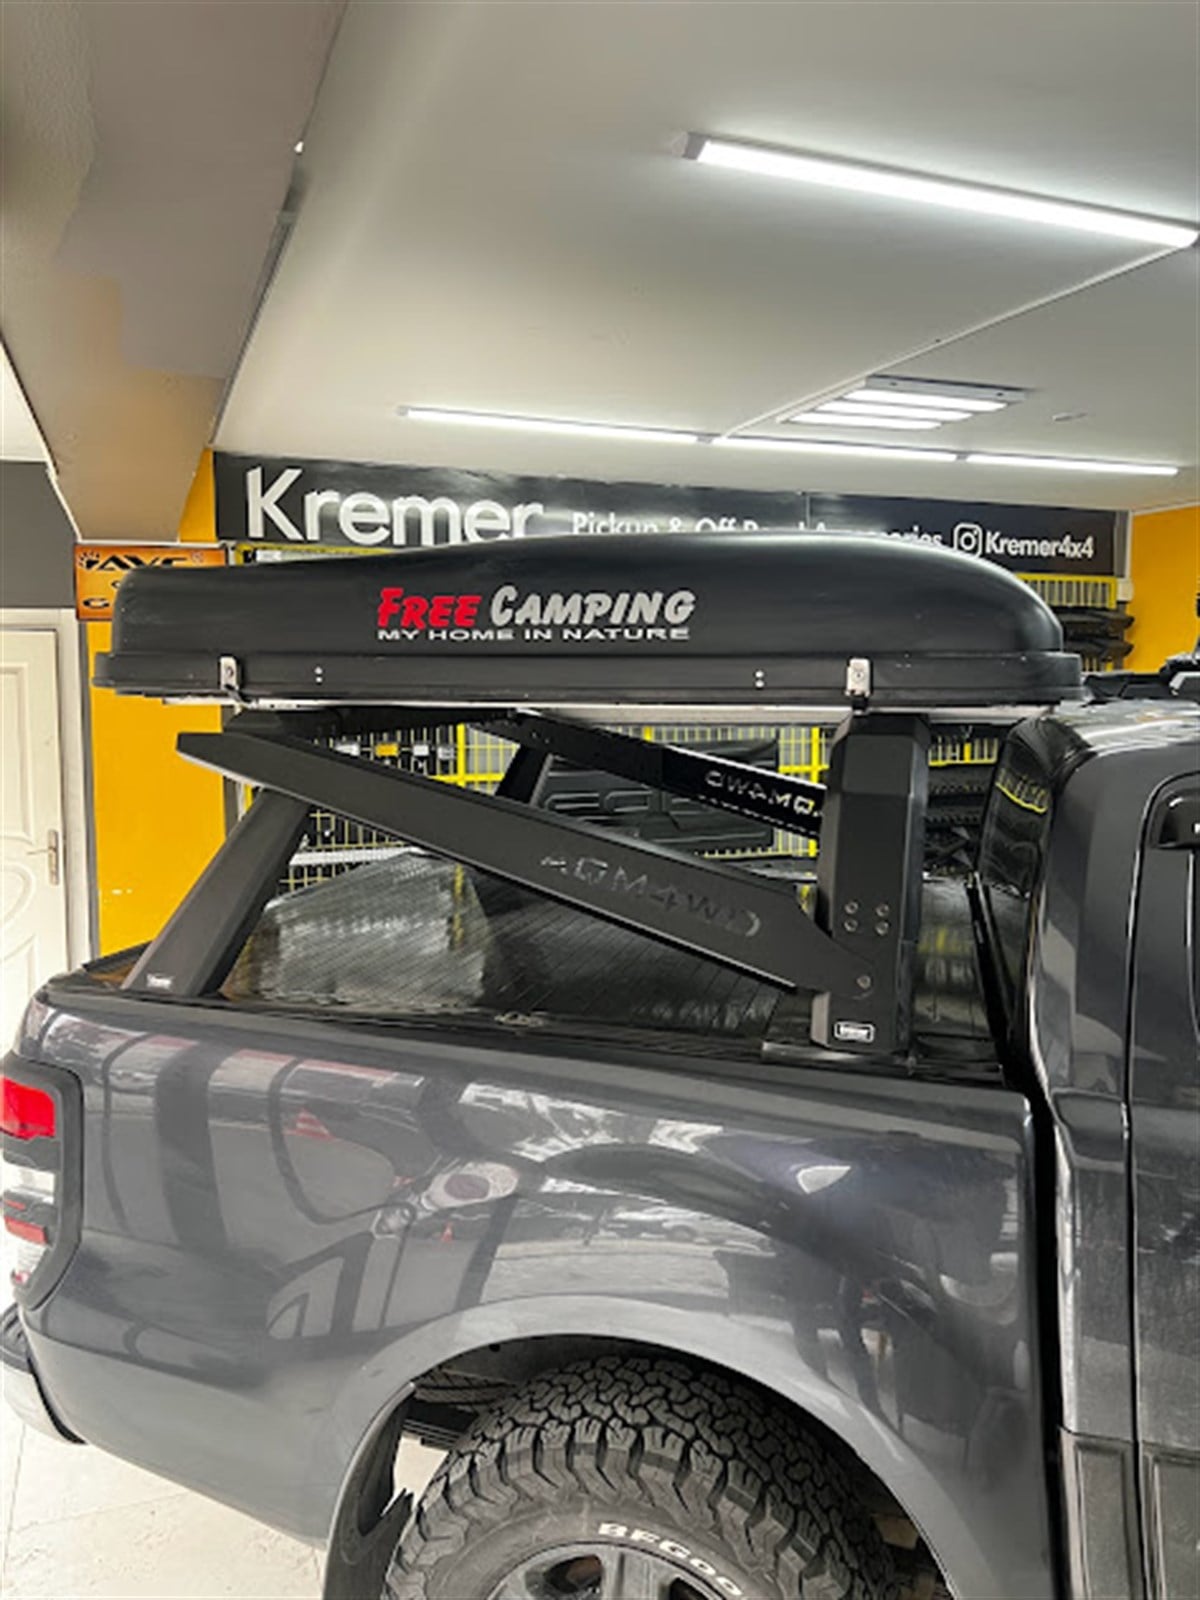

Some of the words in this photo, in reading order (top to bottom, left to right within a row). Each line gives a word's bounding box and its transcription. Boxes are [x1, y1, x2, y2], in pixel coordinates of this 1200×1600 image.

[246, 467, 544, 546] Kremer
[986, 531, 1094, 558] Kremer4x4
[490, 585, 696, 626] CAMPING
[377, 629, 420, 641] MY
[429, 629, 514, 641] HOME
[524, 628, 553, 641] IN
[562, 628, 691, 641] NATURE
